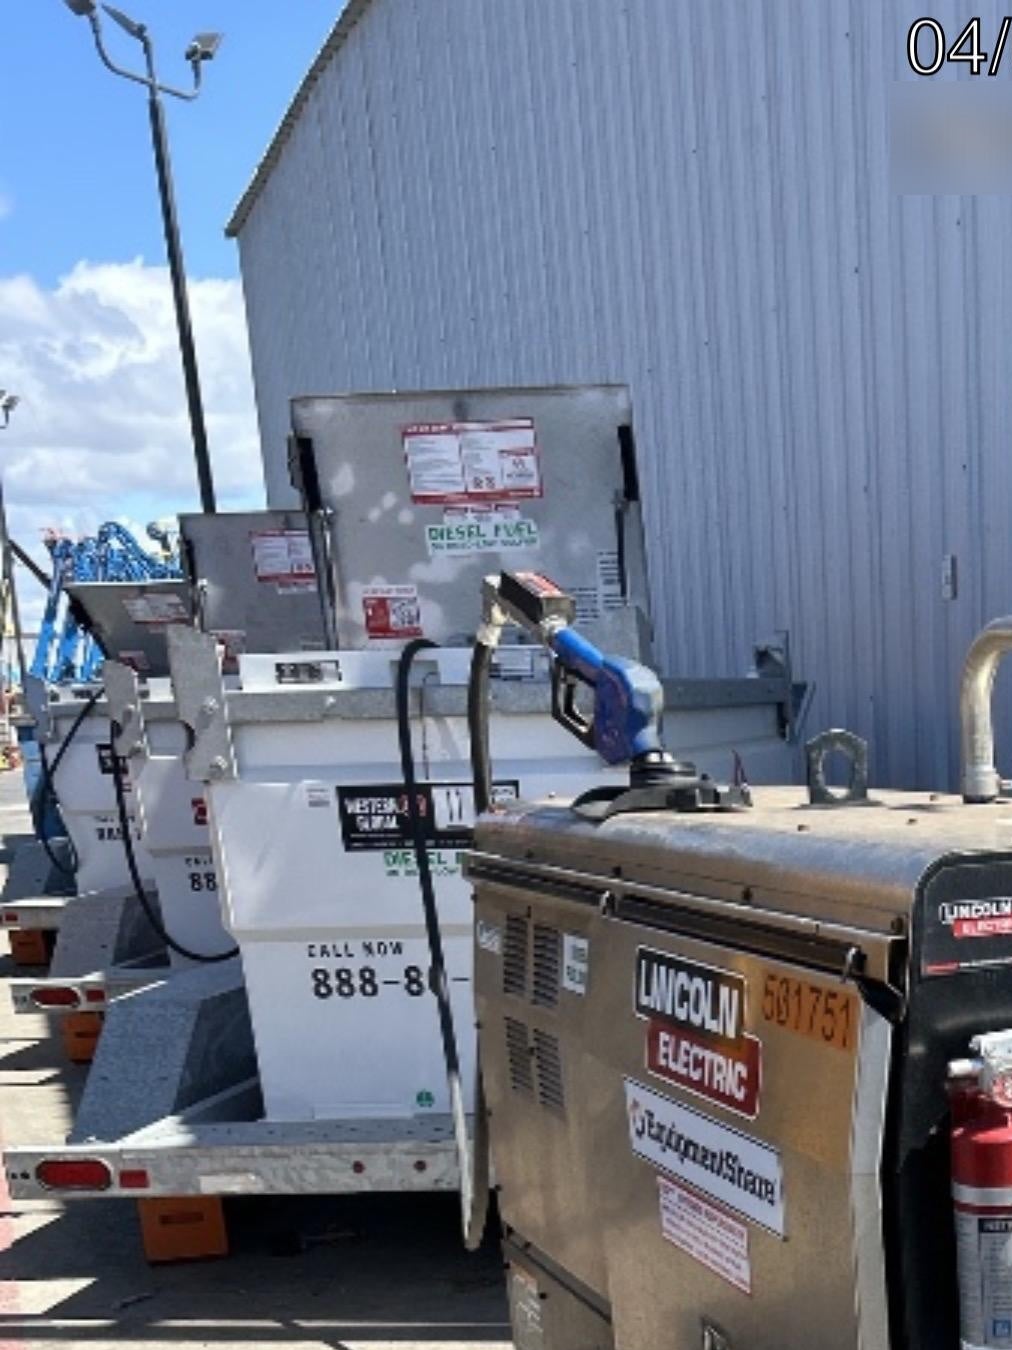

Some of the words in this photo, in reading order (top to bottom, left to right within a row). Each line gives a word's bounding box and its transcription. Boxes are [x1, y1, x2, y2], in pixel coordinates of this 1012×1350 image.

[428, 524, 486, 541] DIESEL
[307, 943, 355, 958] CALL
[363, 941, 403, 957] NOW
[640, 959, 739, 1040] LINCOLN
[658, 1031, 748, 1101] ELECTRIC
[644, 1109, 776, 1207] EquipmentShare
